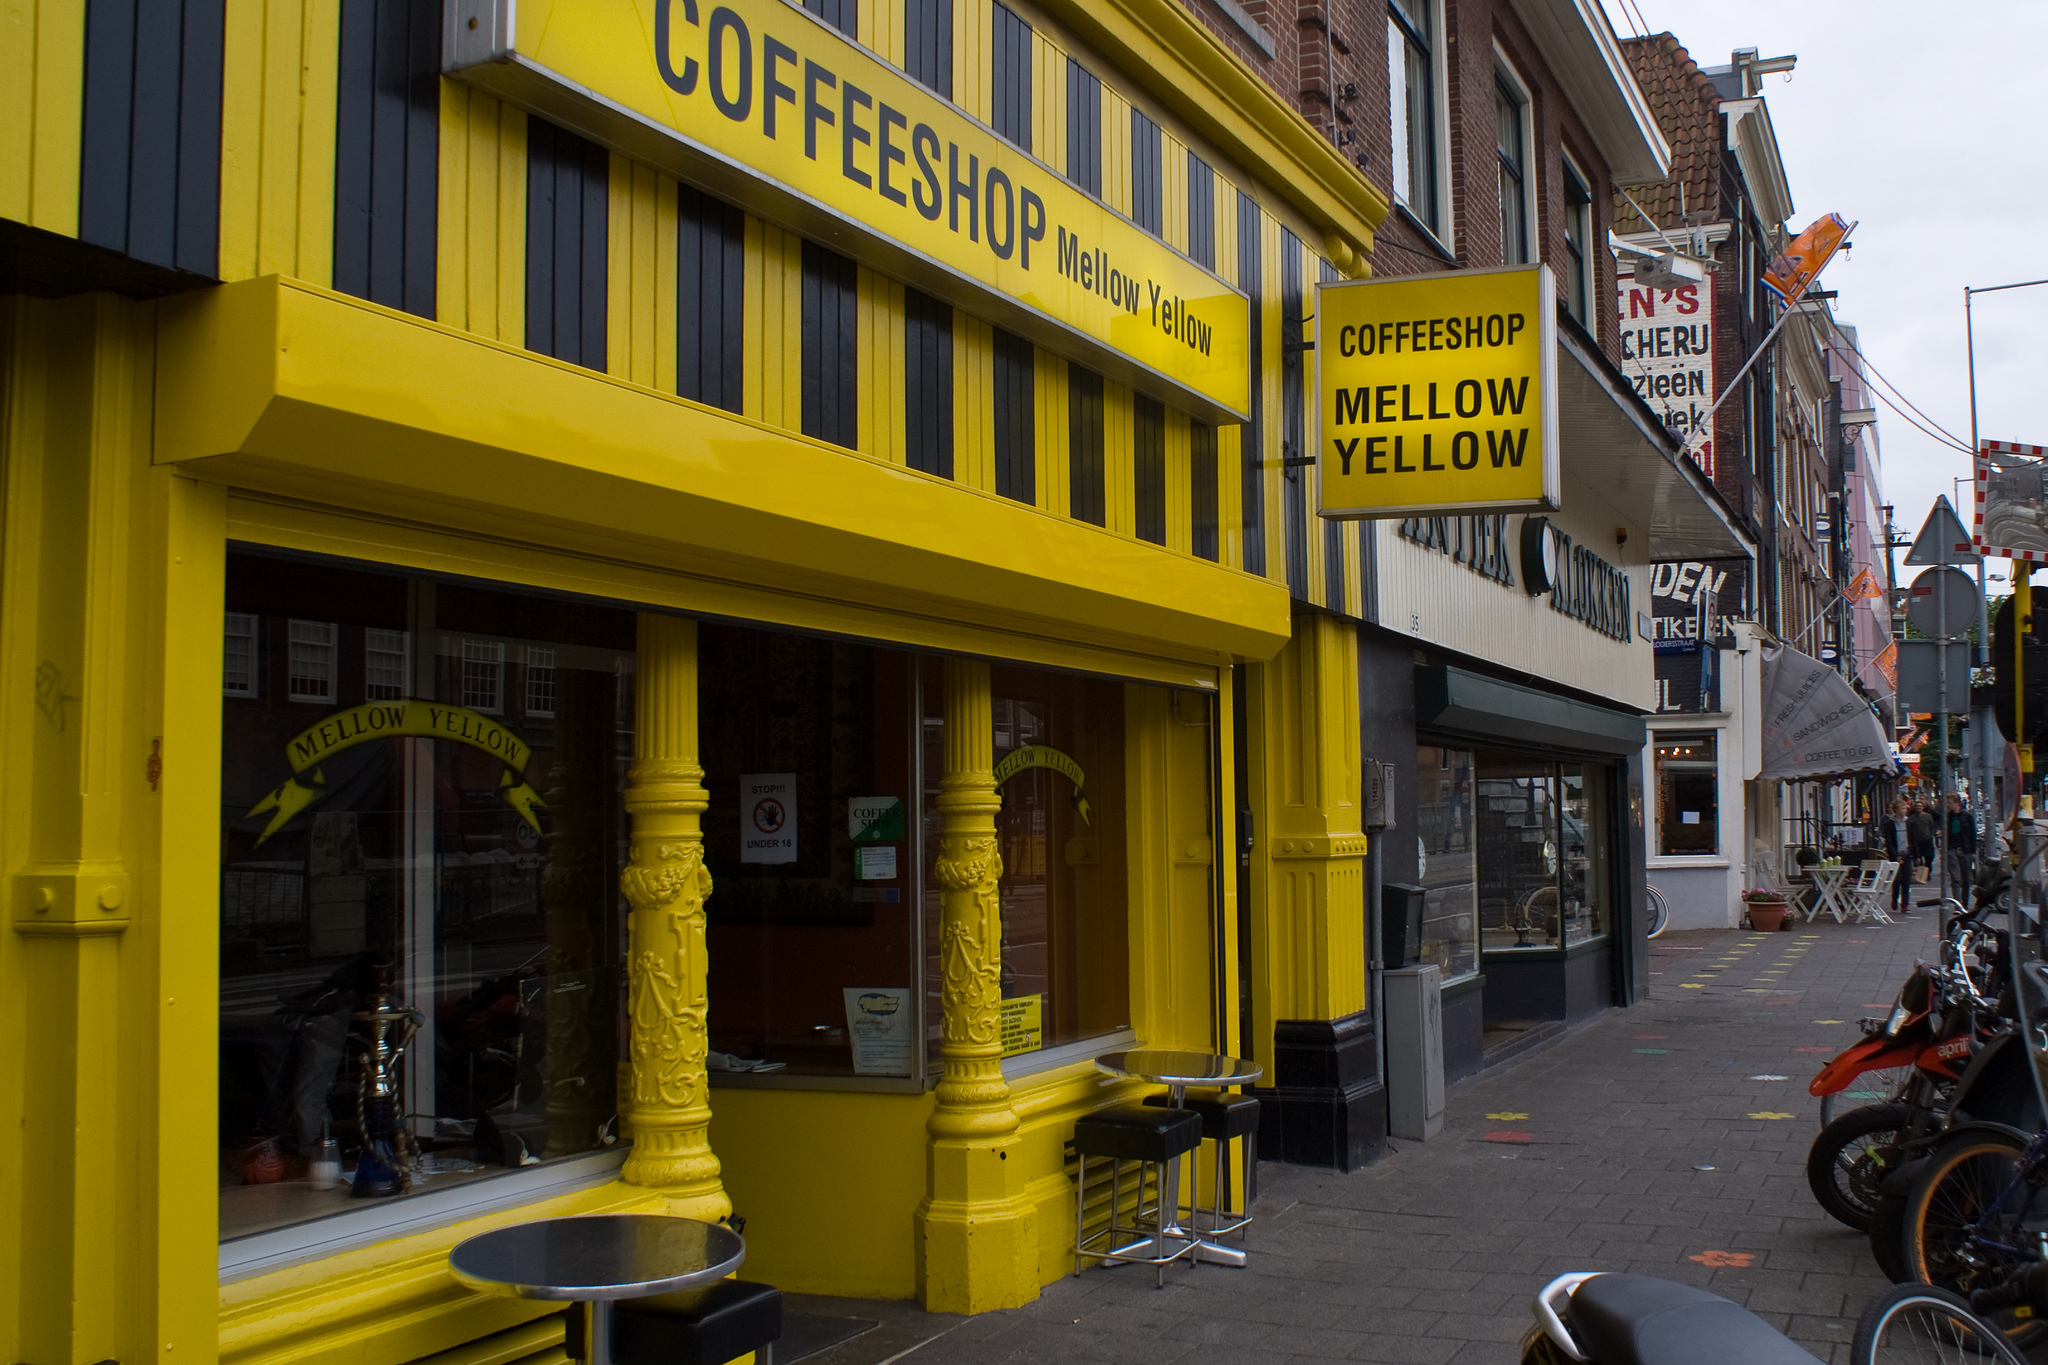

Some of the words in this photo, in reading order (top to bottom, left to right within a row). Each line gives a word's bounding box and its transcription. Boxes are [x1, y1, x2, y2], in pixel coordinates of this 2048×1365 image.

[655, 0, 1046, 271] COFFEESHOP
[1057, 225, 1140, 316] Mellow
[1148, 279, 1212, 357] Yellow
[1340, 313, 1525, 358] COFFEESHOP
[1335, 376, 1529, 426] MELLOW
[1333, 428, 1528, 476] YELLOW
[1551, 526, 1632, 643] KLOKKEN
[1411, 614, 1420, 632] 35
[1774, 698, 1799, 727] FRESH
[1798, 669, 1822, 700] JUICES
[294, 706, 407, 763] MELLOW
[430, 708, 522, 762] YELLOW
[1793, 702, 1855, 742] SANDWICHES
[995, 749, 1036, 781] MELLOW
[1044, 750, 1081, 784] YELLOW
[1805, 750, 1841, 762] COFFEE
[1842, 748, 1857, 757] TO
[1858, 746, 1873, 756] GO
[752, 785, 786, 794] STOP!!!
[853, 808, 900, 819] COFFEE
[861, 819, 893, 829] SHOP
[747, 840, 779, 849] UNDER
[782, 839, 792, 847] 18
[1937, 1037, 1969, 1058] aprili
